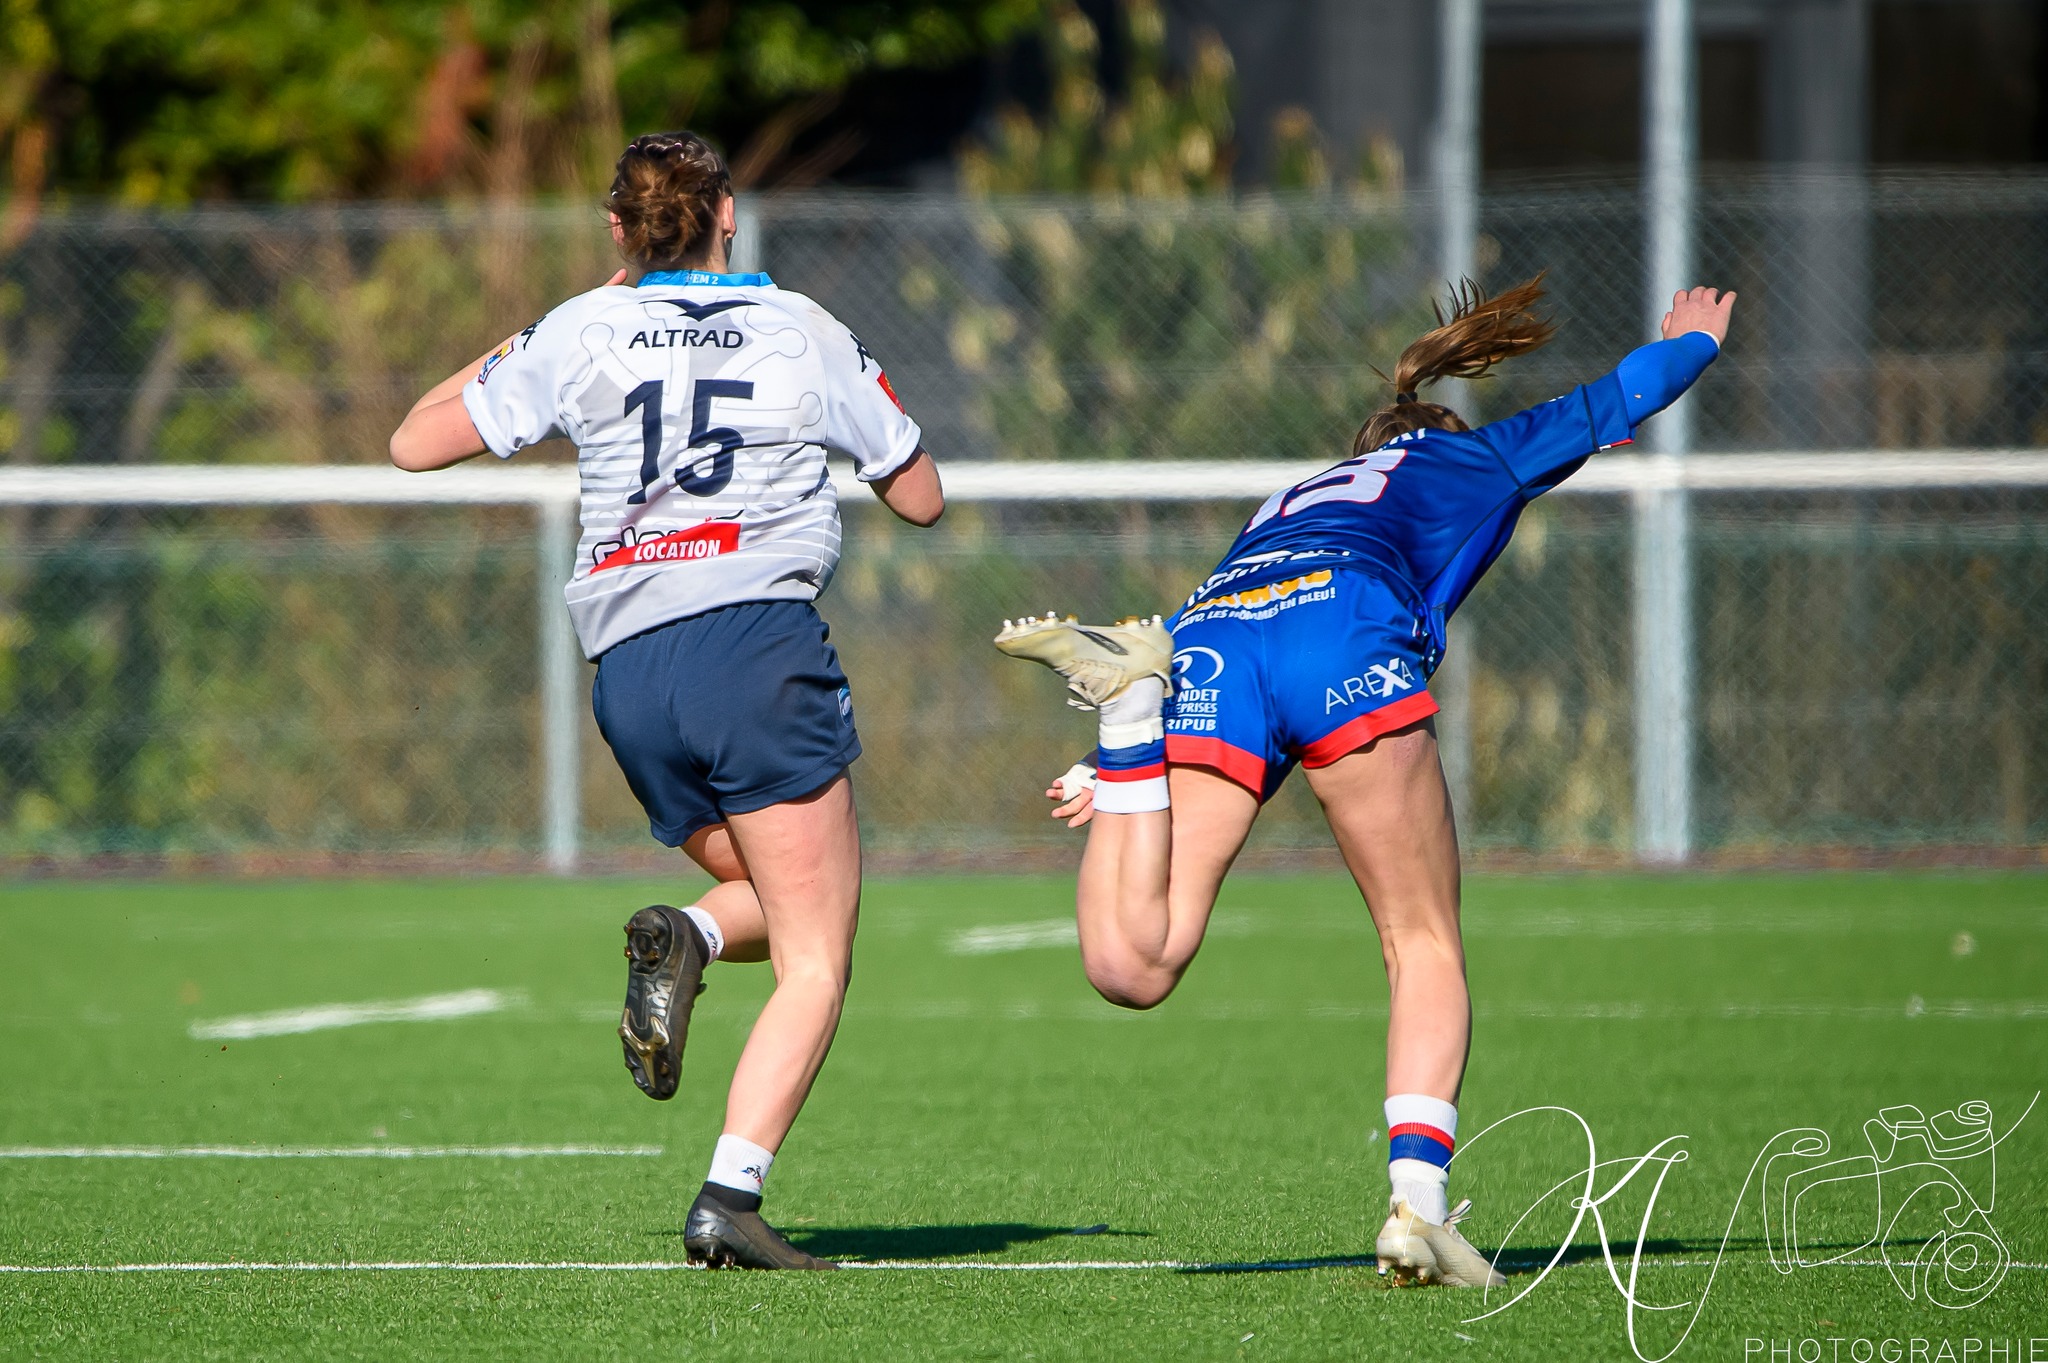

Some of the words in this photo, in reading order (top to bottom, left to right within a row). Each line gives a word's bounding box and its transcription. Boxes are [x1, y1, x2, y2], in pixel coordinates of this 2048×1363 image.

[711, 275, 719, 285] 2
[628, 329, 744, 349] ALTRAD
[624, 379, 754, 505] 15
[634, 539, 721, 561] LOCATION
[1280, 598, 1297, 611] EN
[1298, 587, 1336, 605] BLEU!
[1325, 657, 1415, 715] AREXA
